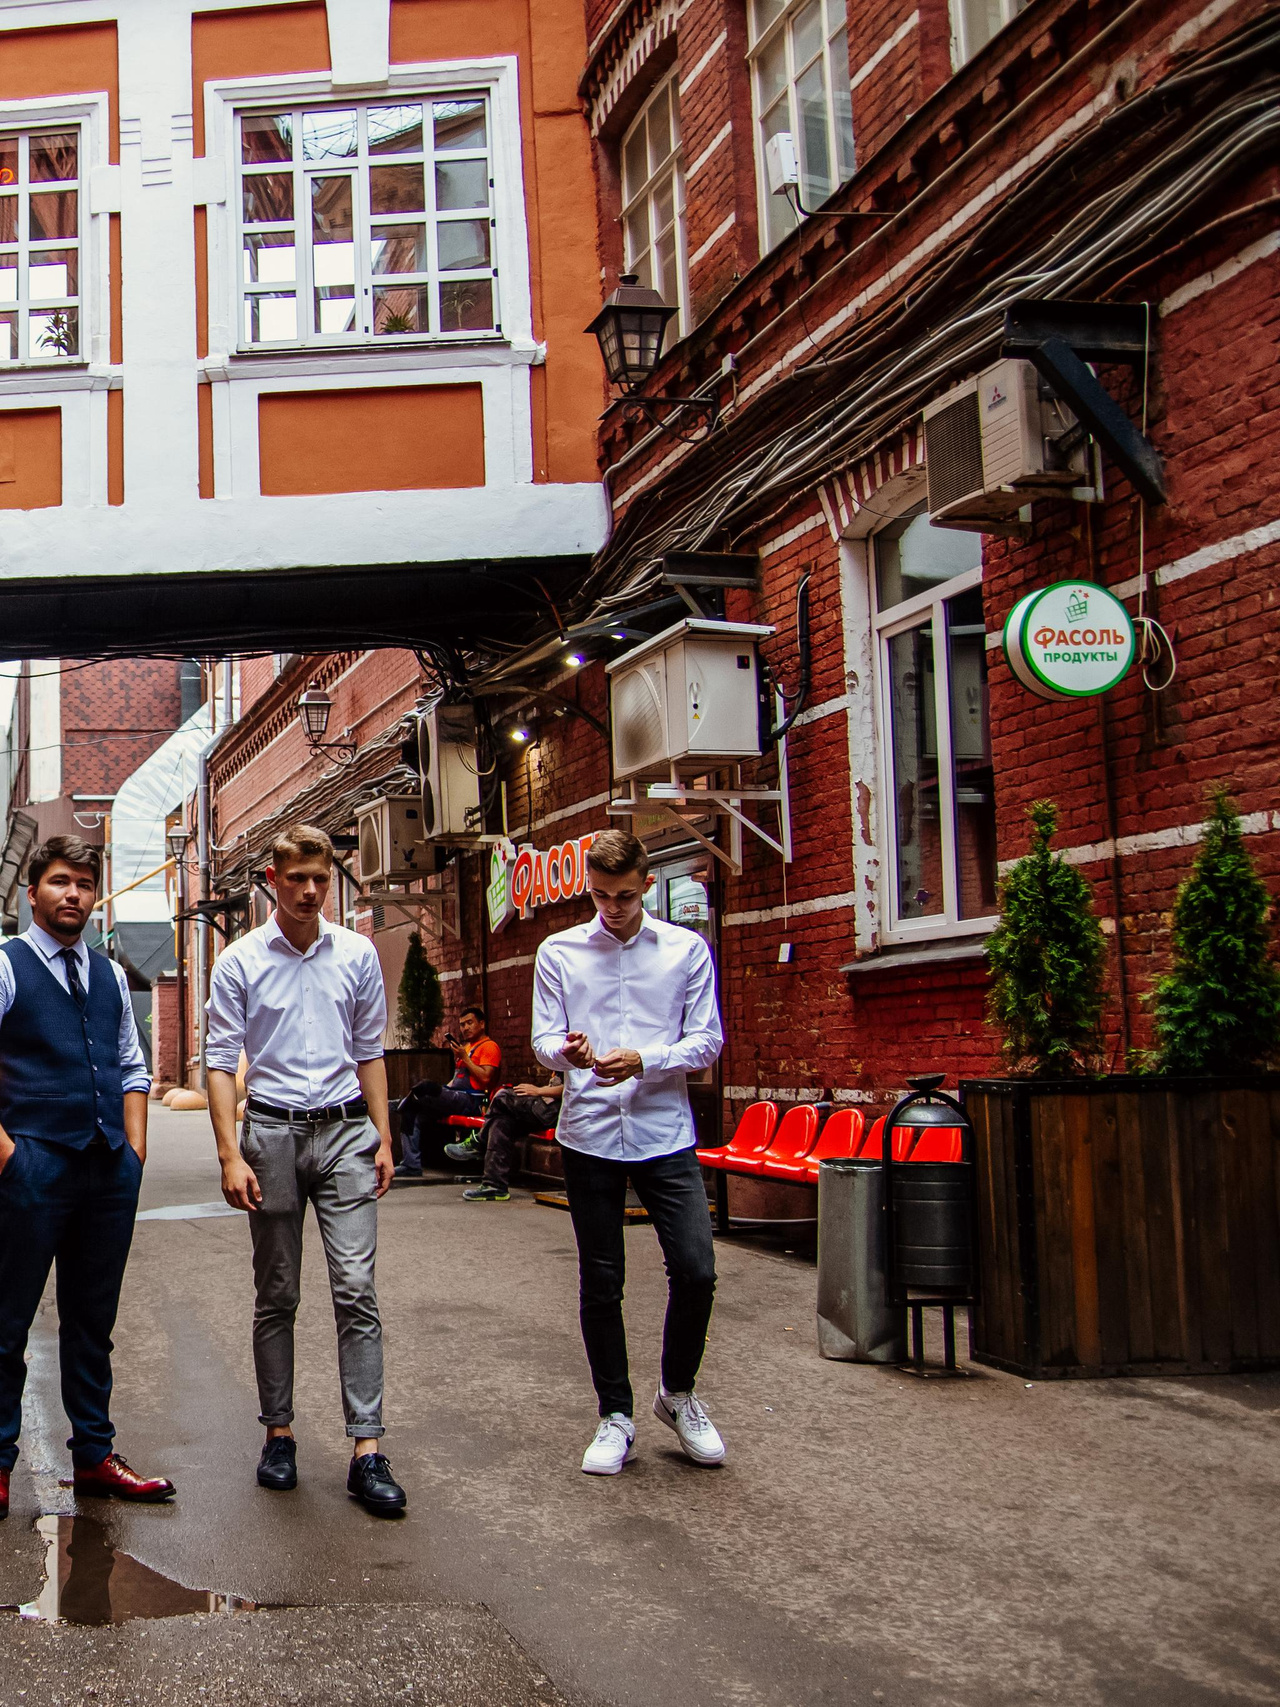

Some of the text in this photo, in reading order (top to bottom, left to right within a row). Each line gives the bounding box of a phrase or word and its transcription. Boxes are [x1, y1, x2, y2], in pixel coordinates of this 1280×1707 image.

[1033, 626, 1125, 649] ФАСОЛЬ
[1043, 652, 1118, 664] ПРОДУКТЫ
[511, 833, 601, 920] ФАСОЛ
